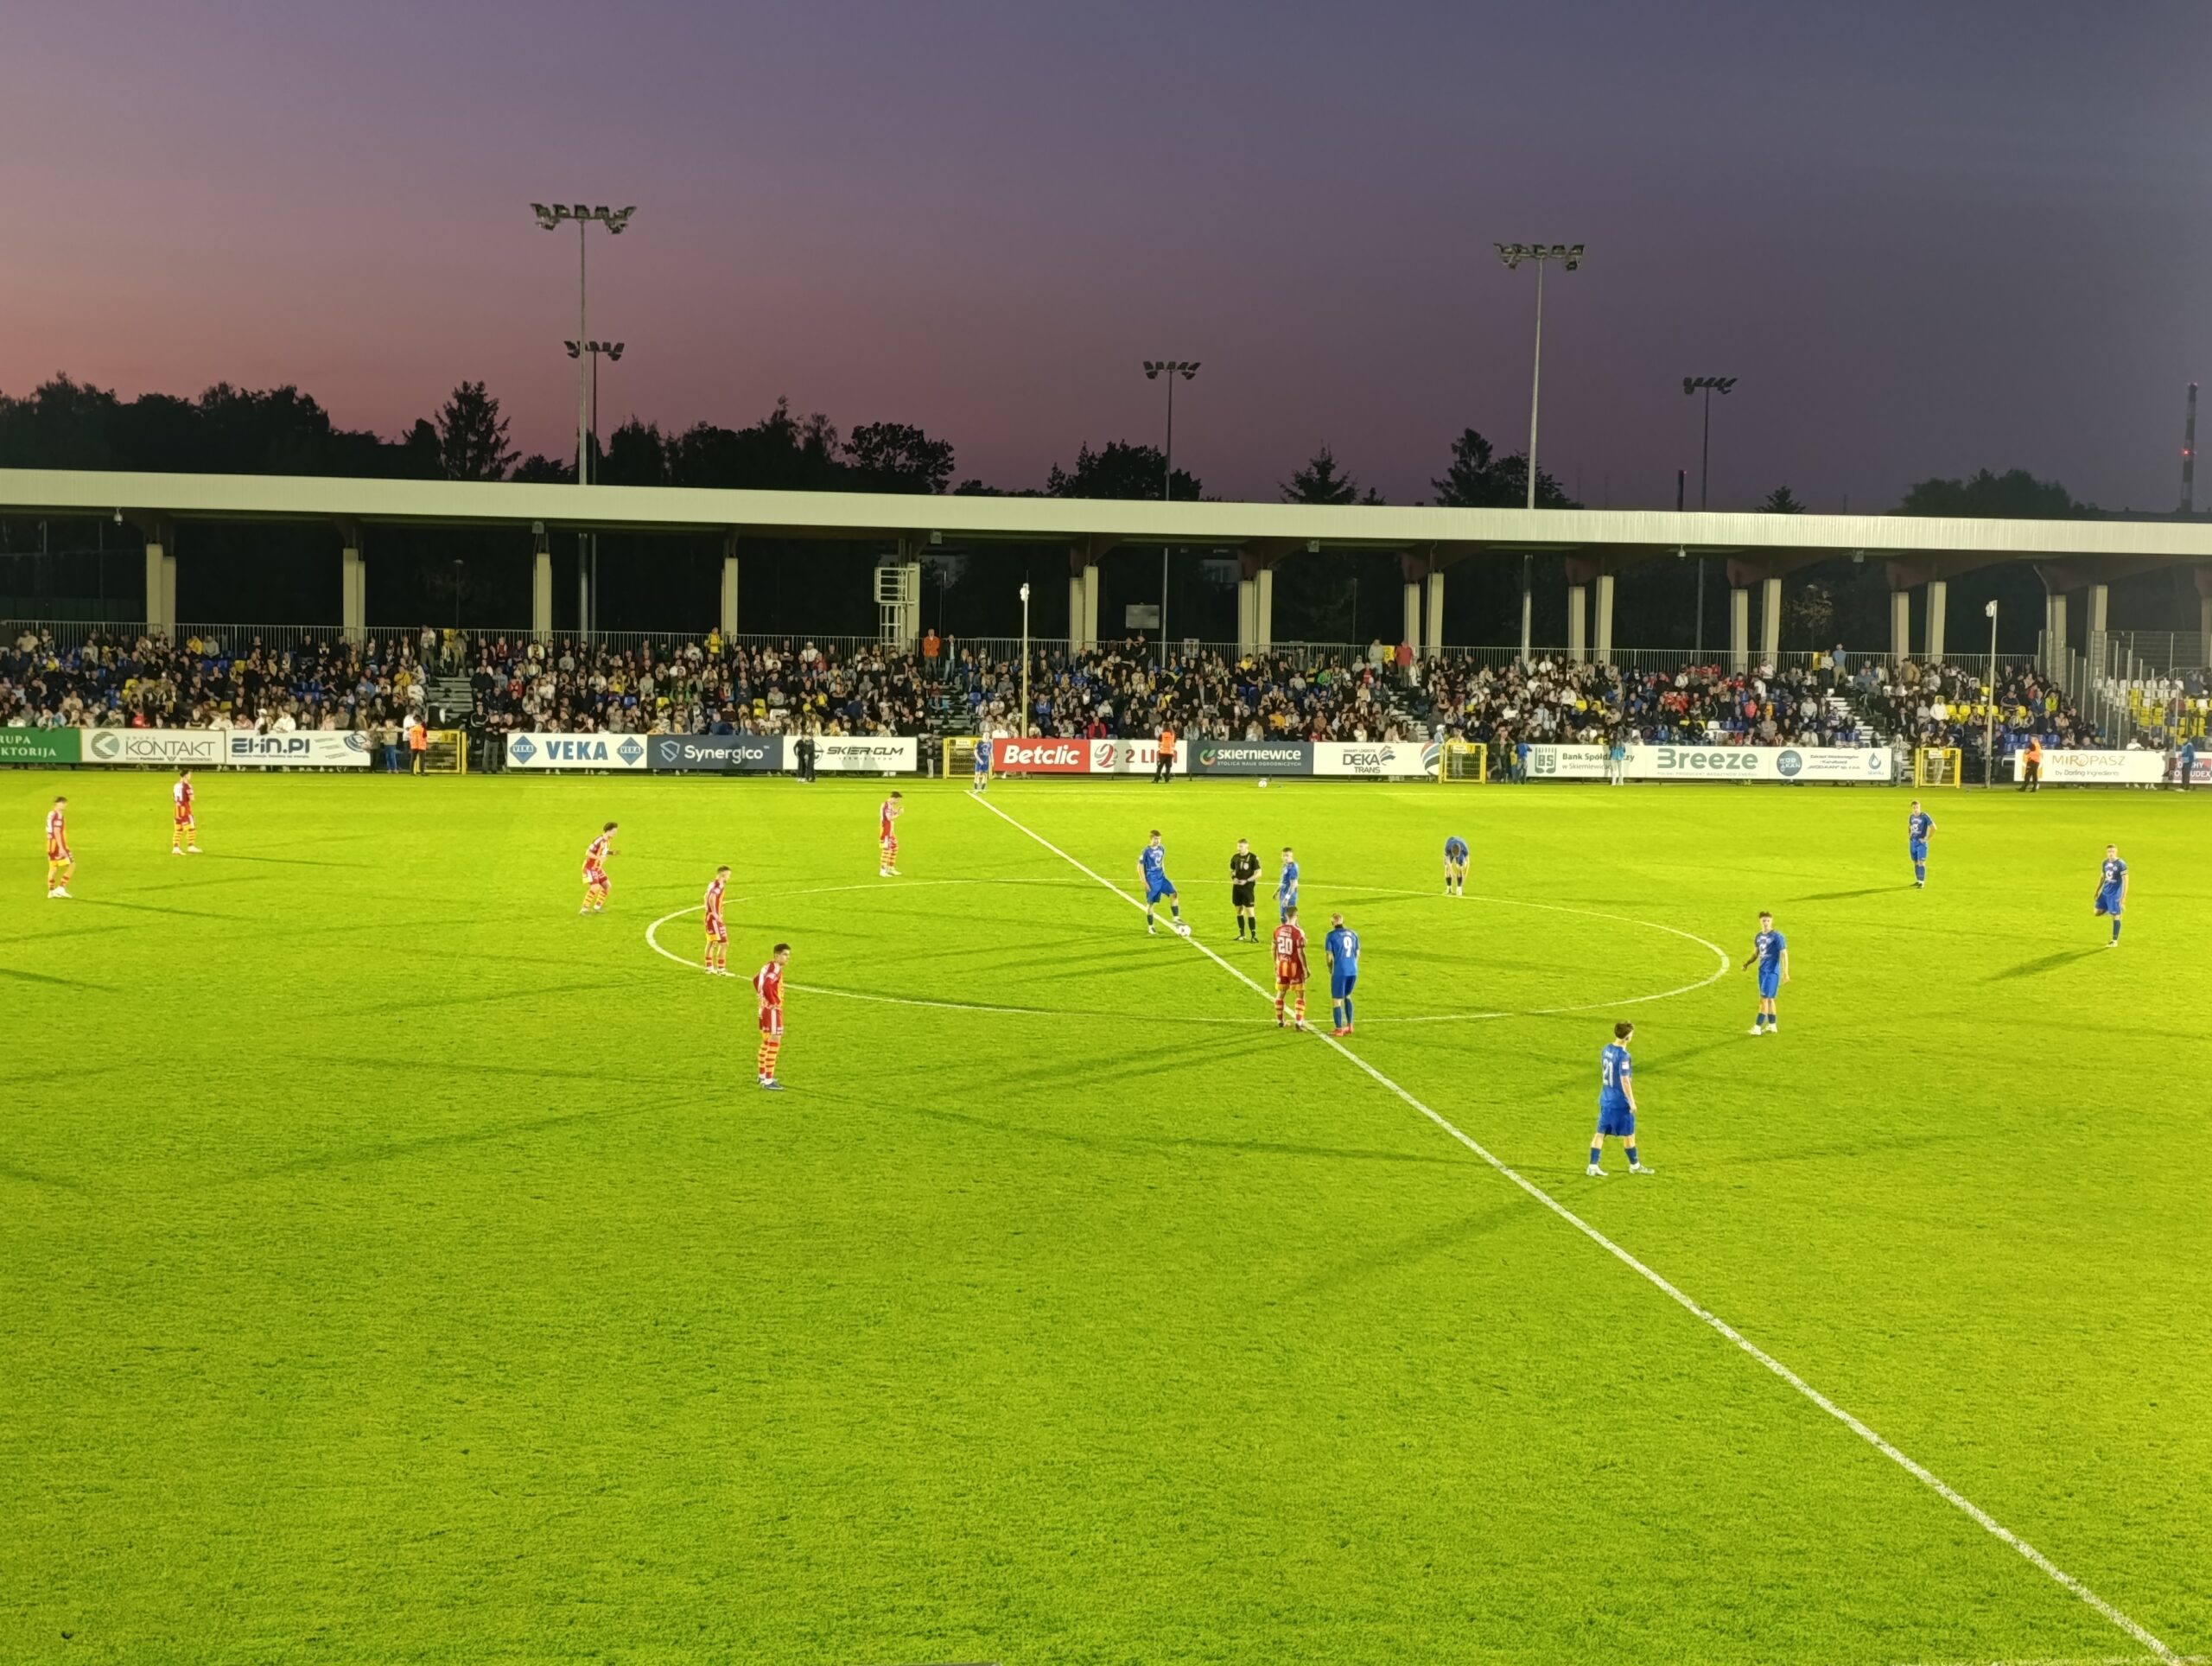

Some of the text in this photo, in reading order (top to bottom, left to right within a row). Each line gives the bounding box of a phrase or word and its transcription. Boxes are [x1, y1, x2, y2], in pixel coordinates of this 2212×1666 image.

[125, 740, 216, 756] KONTAKT
[545, 741, 608, 760] VEKA
[683, 744, 763, 764] Synergico
[1002, 745, 1080, 765] Betclic
[1125, 748, 1135, 763] 2
[1343, 754, 1380, 766] DEKA
[1538, 754, 1554, 766] BS
[1585, 753, 1636, 763] Spółdzy
[1657, 747, 1758, 770] Breeze
[2052, 754, 2126, 766] MIROPASZ
[1277, 937, 1293, 955] 20
[1343, 936, 1352, 957] 9
[1603, 1059, 1613, 1087] 21
